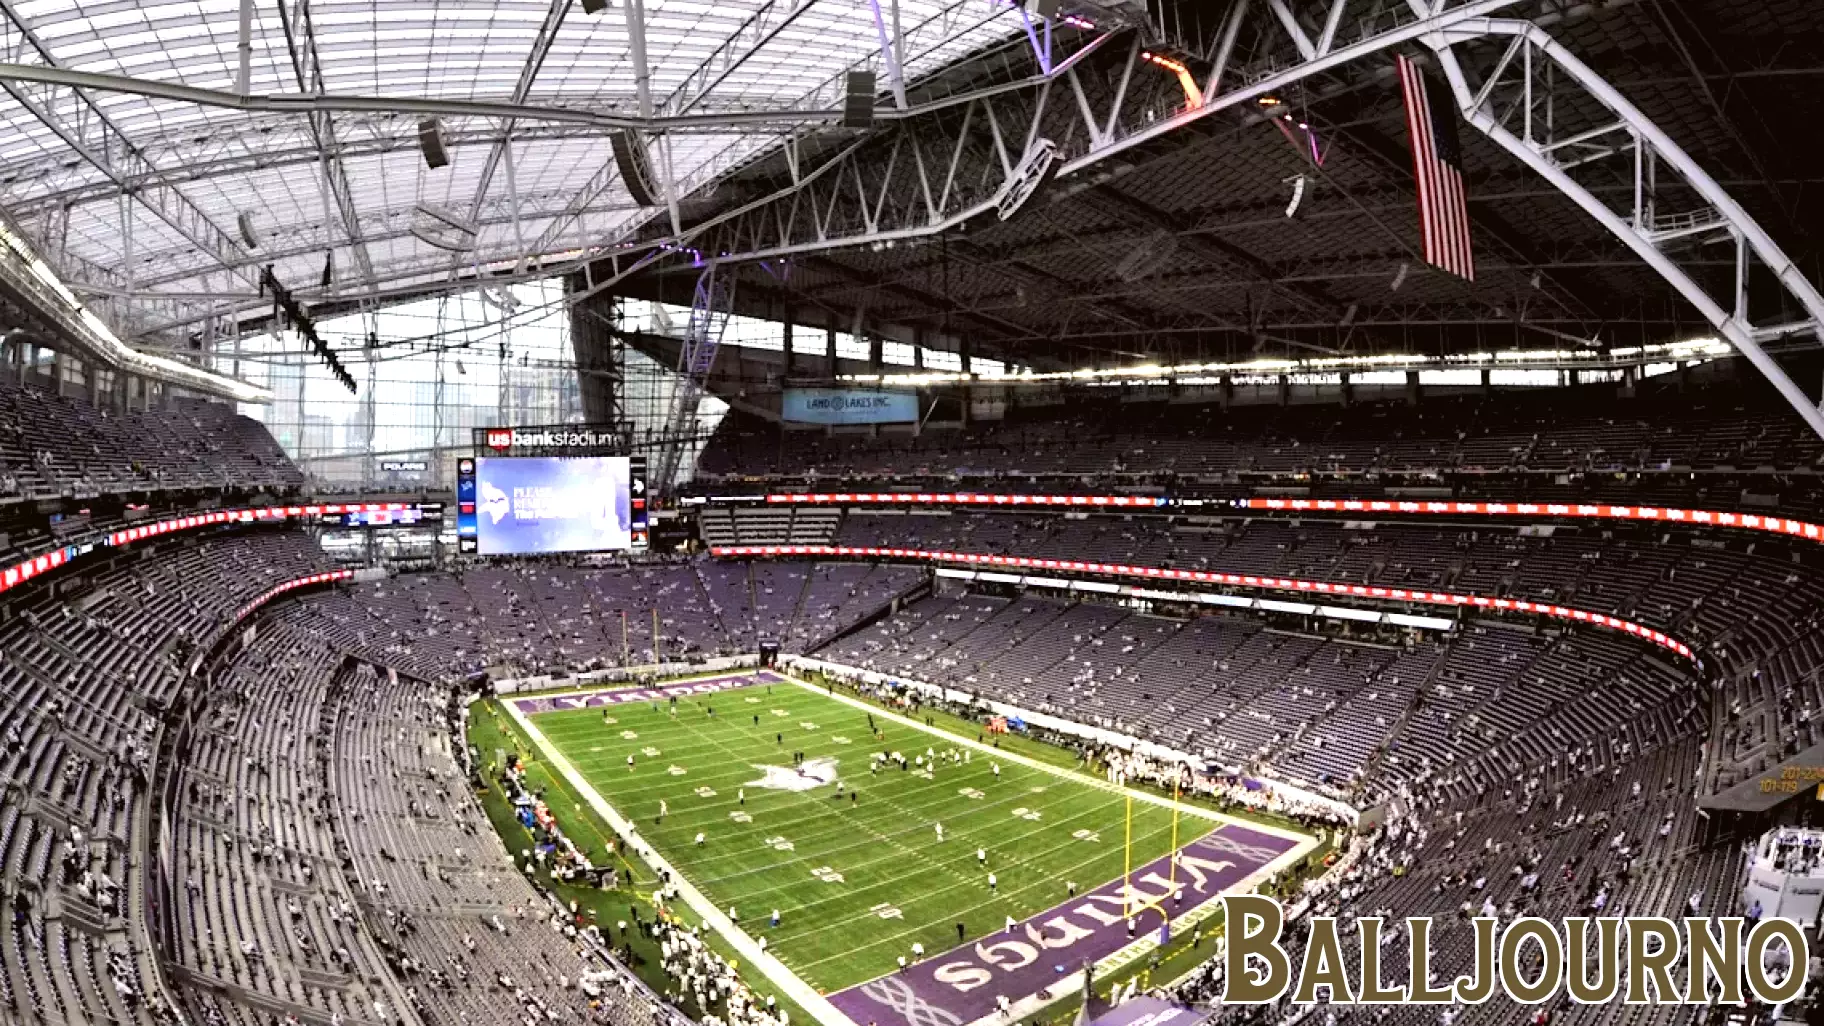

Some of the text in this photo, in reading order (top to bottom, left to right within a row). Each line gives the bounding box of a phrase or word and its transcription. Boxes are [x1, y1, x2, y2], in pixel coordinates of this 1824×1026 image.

[807, 398, 830, 410] LAND
[845, 396, 871, 408] LAKES
[383, 463, 426, 471] POLARIS
